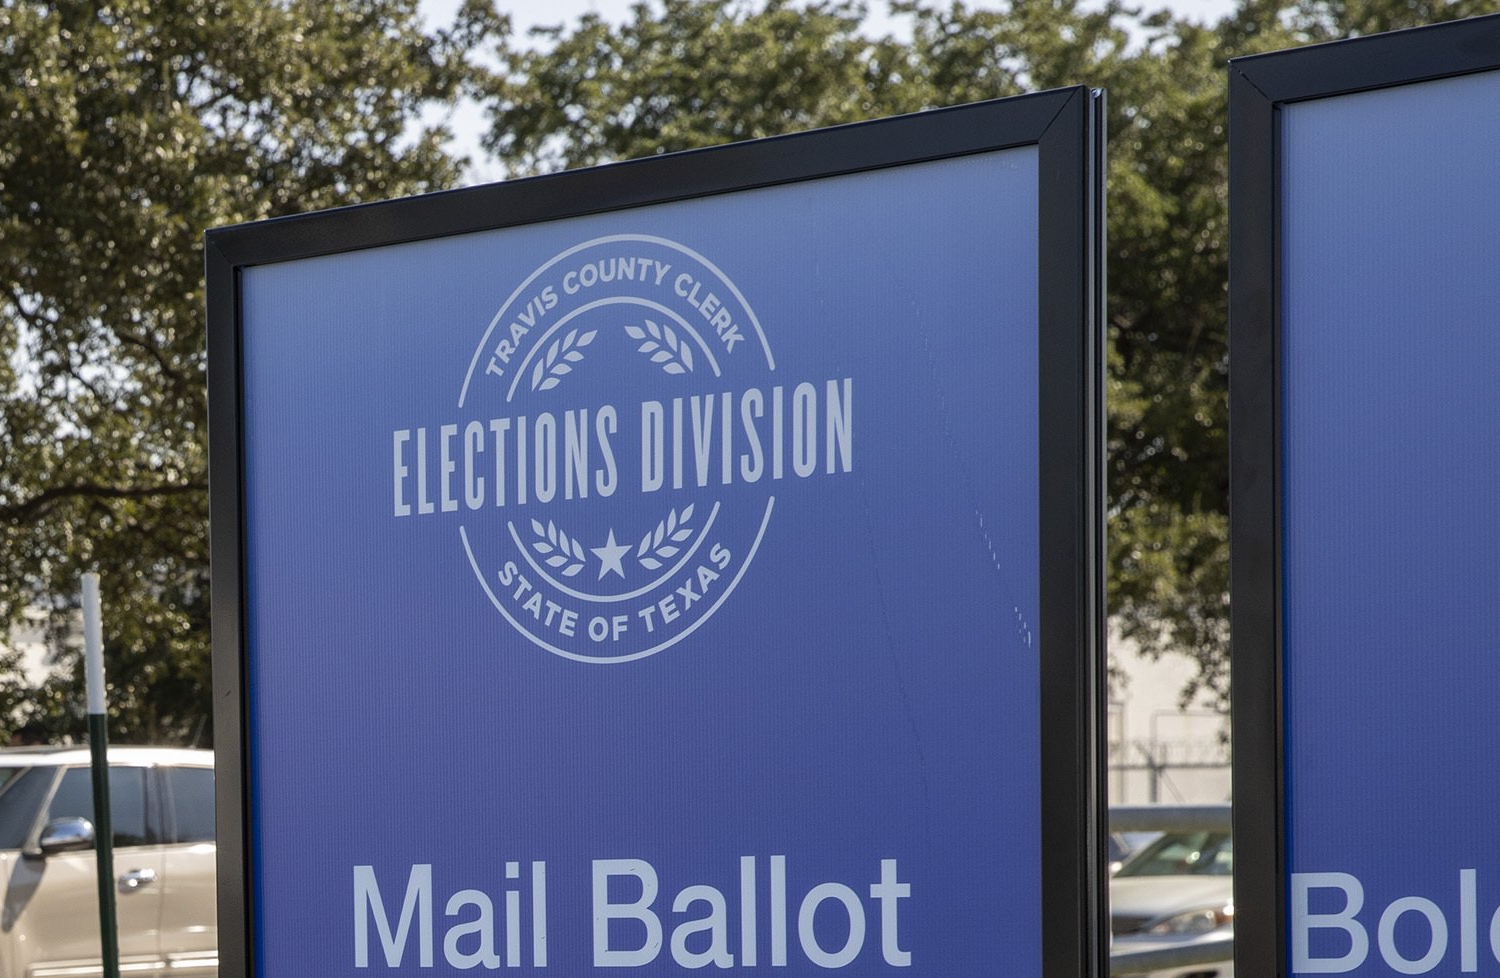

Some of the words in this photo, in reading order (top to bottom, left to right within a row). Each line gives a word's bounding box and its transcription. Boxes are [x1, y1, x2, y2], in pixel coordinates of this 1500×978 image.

[486, 286, 559, 377] TRAVIS
[562, 257, 672, 295] COUNTY
[675, 273, 745, 354] CLERK
[393, 404, 618, 518] ELECTIONS
[641, 377, 853, 493] DIVISION
[497, 561, 579, 638] STATE
[588, 614, 629, 642] OF
[637, 543, 732, 633] TEXAS
[353, 861, 548, 969] Mail
[591, 855, 912, 969] Ballot
[1290, 868, 1500, 975] Bol
